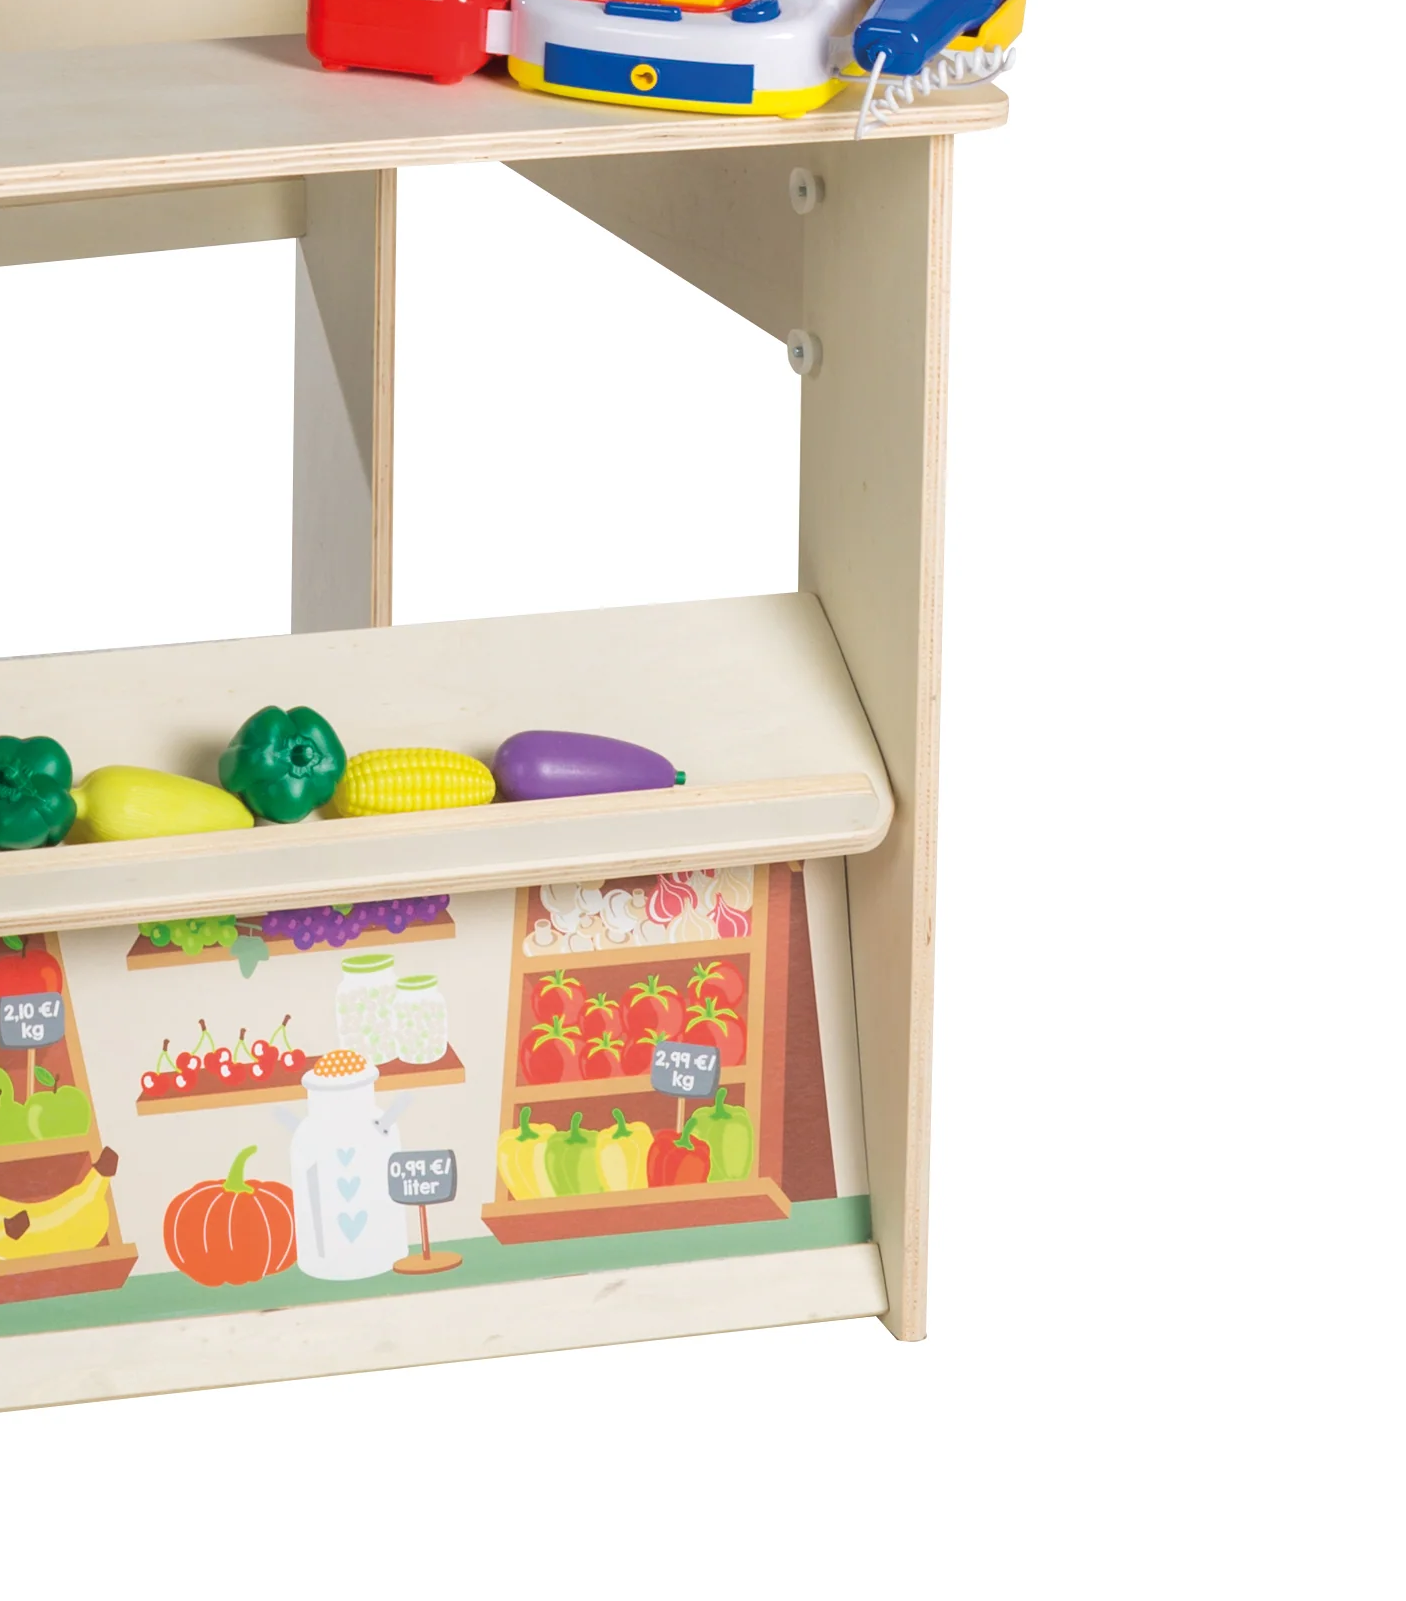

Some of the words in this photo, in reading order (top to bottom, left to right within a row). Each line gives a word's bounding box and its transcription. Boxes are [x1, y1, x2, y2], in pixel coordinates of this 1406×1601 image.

[4, 1003, 34, 1022] 2,10
[38, 1000, 60, 1018] €/
[21, 1022, 44, 1041] kg
[655, 1050, 691, 1069] 2,99
[694, 1054, 716, 1071] €/
[672, 1070, 694, 1091] kg
[390, 1160, 426, 1179] 0,99
[430, 1158, 451, 1175] €/
[403, 1179, 440, 1196] liter
